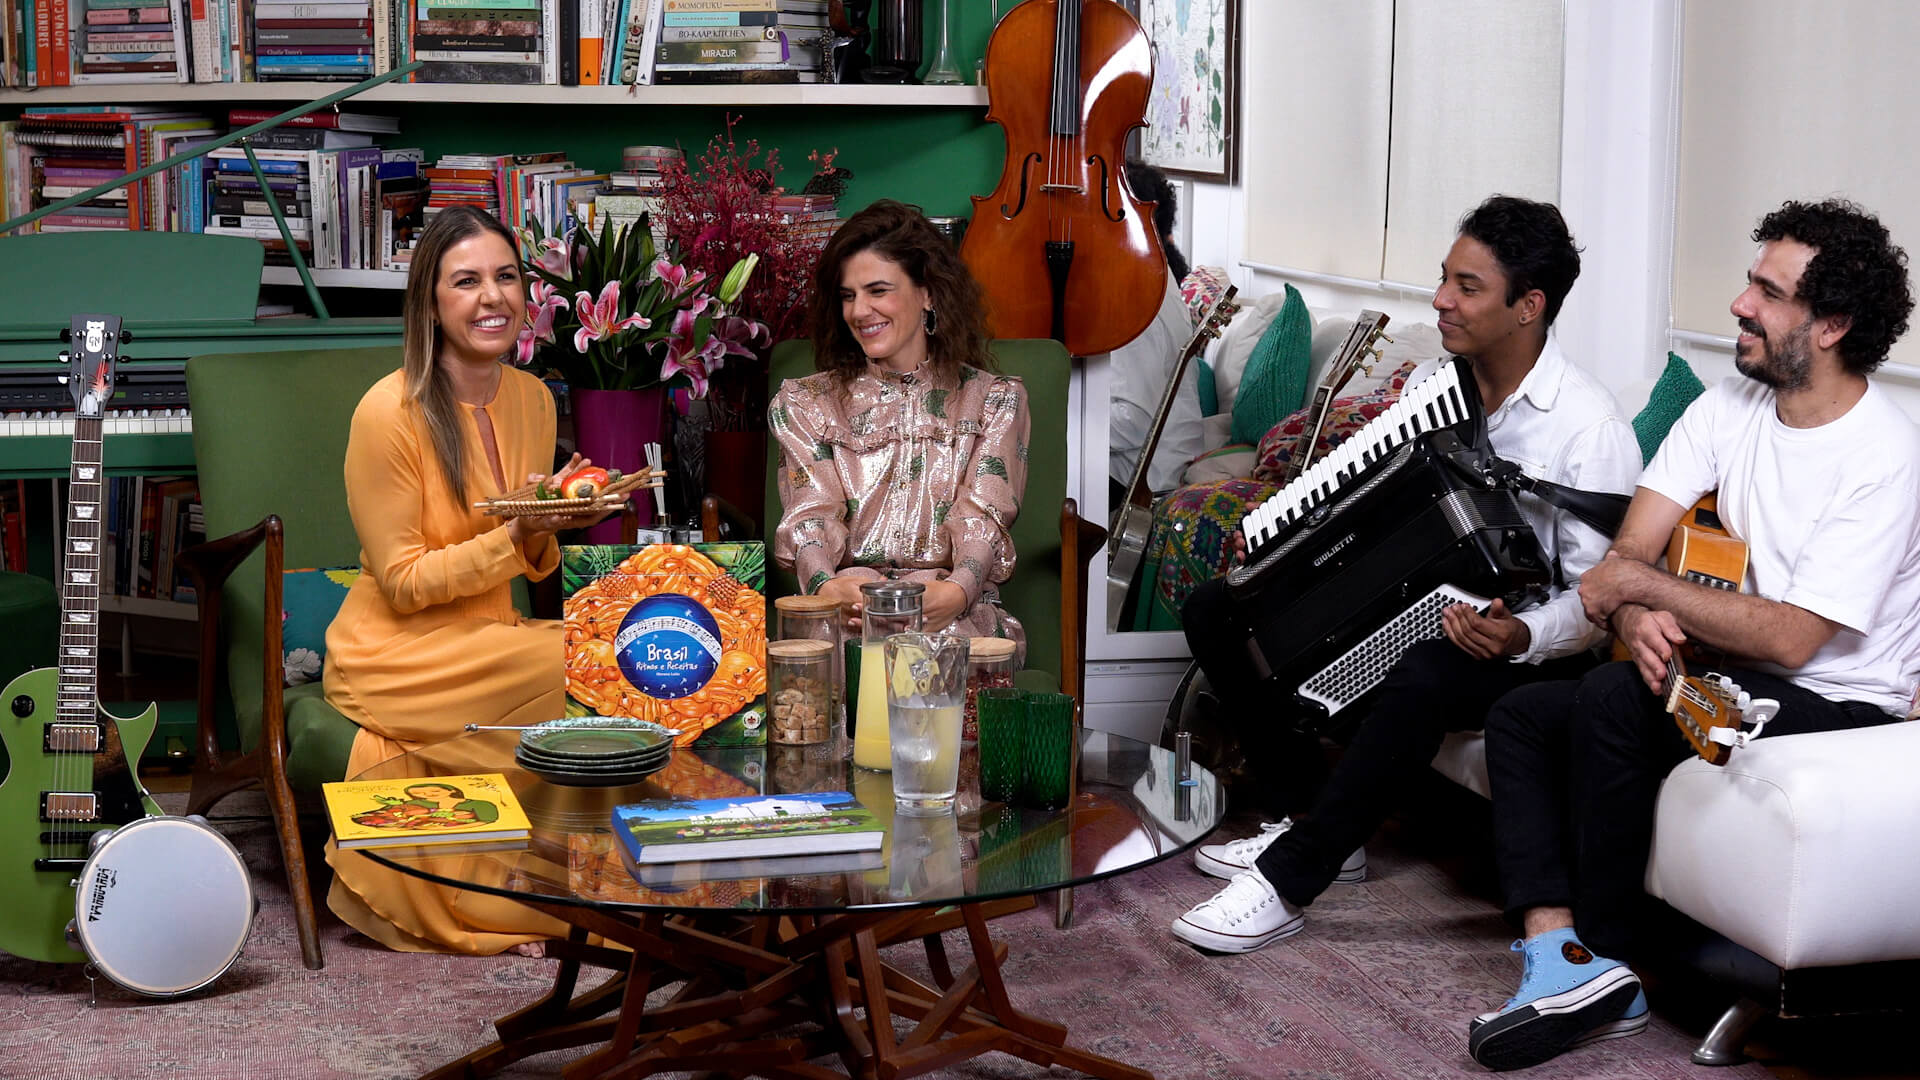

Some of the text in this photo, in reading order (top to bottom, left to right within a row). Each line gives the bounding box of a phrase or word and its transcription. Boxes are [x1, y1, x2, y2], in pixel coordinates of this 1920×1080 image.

[678, 1, 721, 9] MOMOFUKU
[713, 30, 746, 38] KITCHEN
[701, 49, 736, 57] MIRAZUR
[647, 643, 688, 661] Brasil
[636, 662, 658, 671] Ritmos
[667, 661, 698, 670] Receitas
